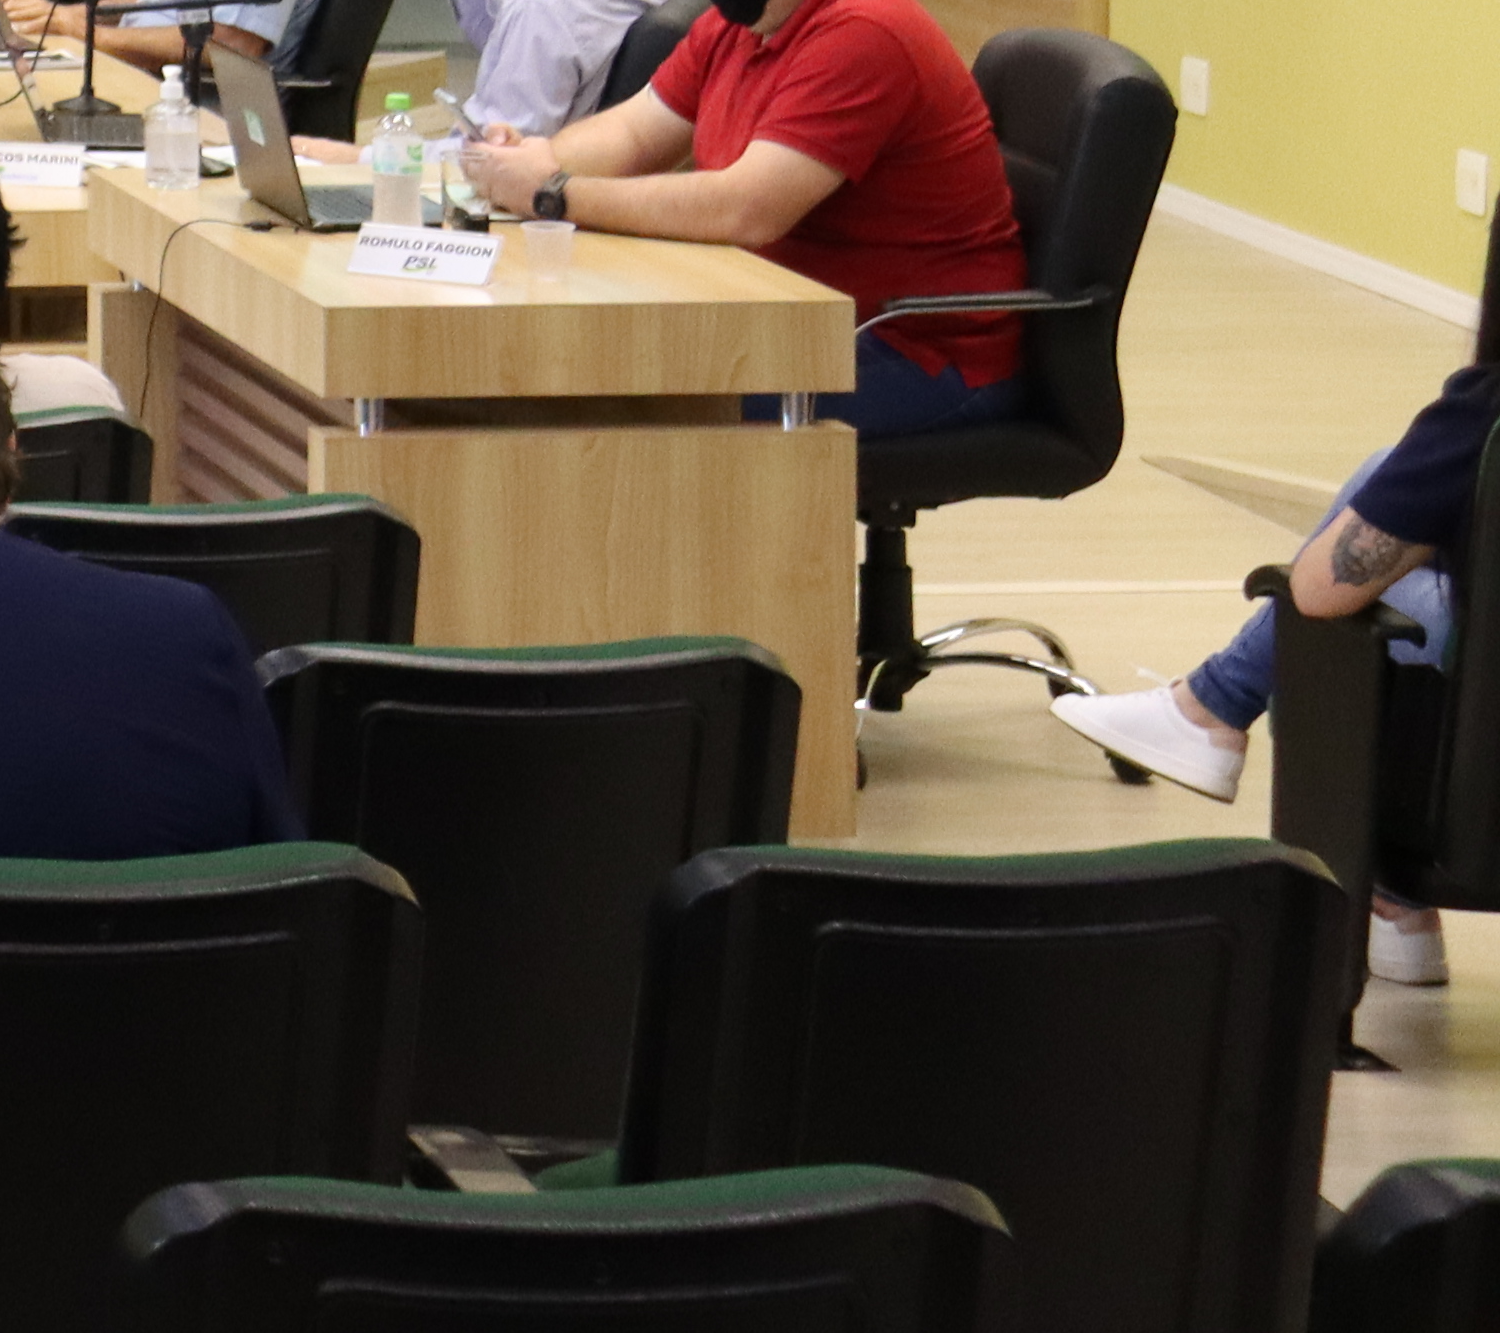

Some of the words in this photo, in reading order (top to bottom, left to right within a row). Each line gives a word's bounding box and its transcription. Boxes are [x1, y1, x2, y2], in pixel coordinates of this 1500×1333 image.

[27, 154, 79, 165] MARINI
[359, 236, 422, 251] ROMULO
[425, 241, 494, 258] FAGGION
[403, 255, 436, 269] PSL
